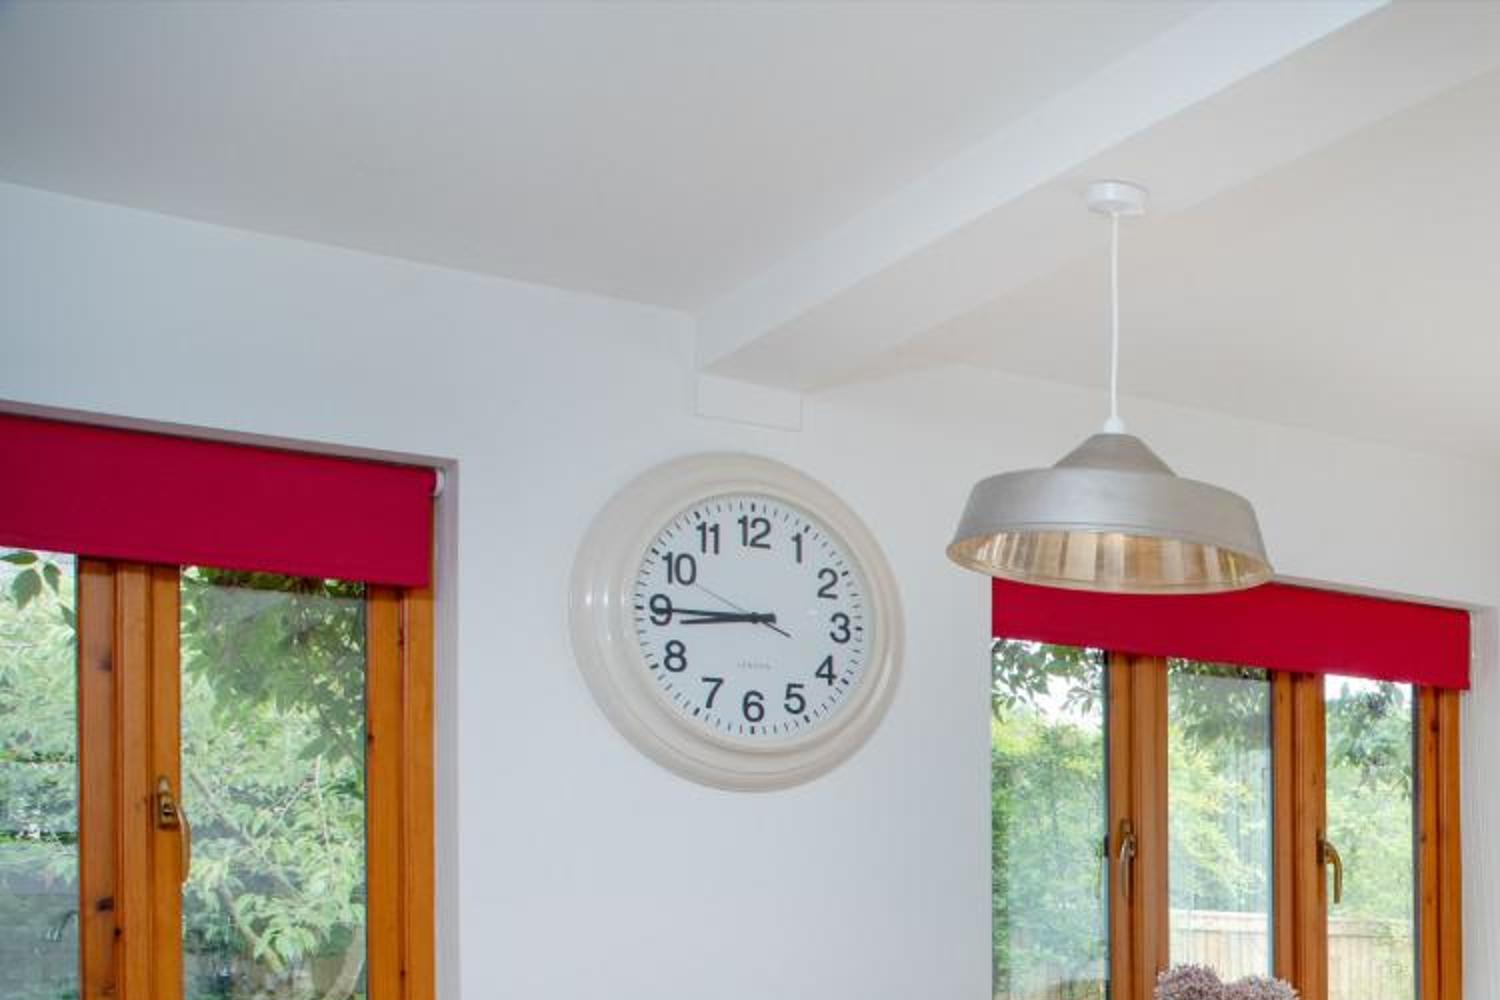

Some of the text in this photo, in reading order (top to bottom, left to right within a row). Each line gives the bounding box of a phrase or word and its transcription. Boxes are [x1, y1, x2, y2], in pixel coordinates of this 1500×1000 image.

[696, 522, 720, 555] 11
[738, 515, 772, 549] 12
[791, 532, 803, 563] 1
[661, 552, 697, 586] 10
[817, 568, 839, 599] 2
[649, 594, 673, 626] 9
[829, 613, 851, 644] 3
[663, 640, 687, 672] 8
[815, 655, 837, 686] 4
[701, 677, 724, 709] 7
[742, 691, 765, 722] 6
[784, 683, 806, 715] 5
